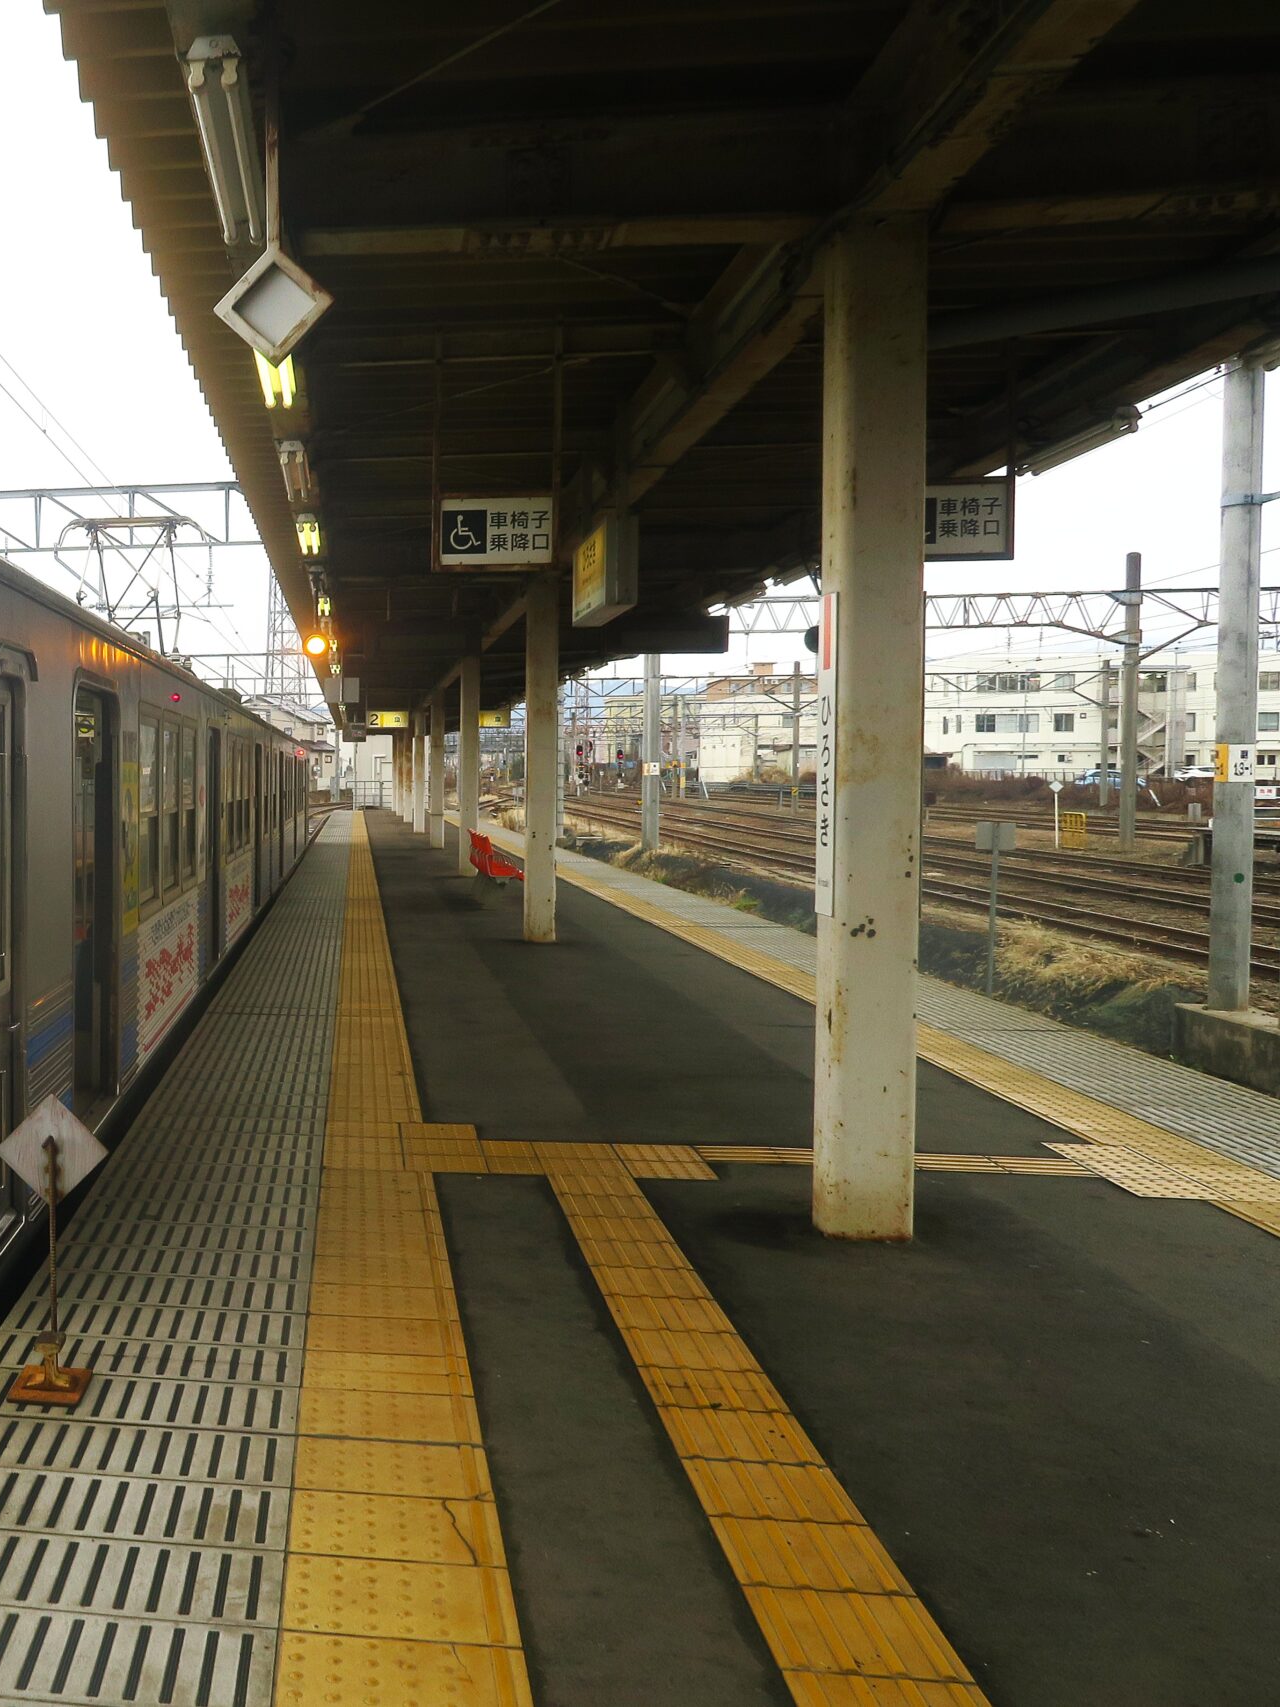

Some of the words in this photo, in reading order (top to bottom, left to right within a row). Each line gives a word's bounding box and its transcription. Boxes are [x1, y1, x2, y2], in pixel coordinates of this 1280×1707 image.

[939, 497, 1001, 516] 車椅子
[489, 511, 550, 529] 車椅子
[939, 519, 999, 538] 乗降口
[489, 533, 549, 551] 乗降口
[370, 713, 379, 726] 2
[820, 695, 832, 848] ひろさき
